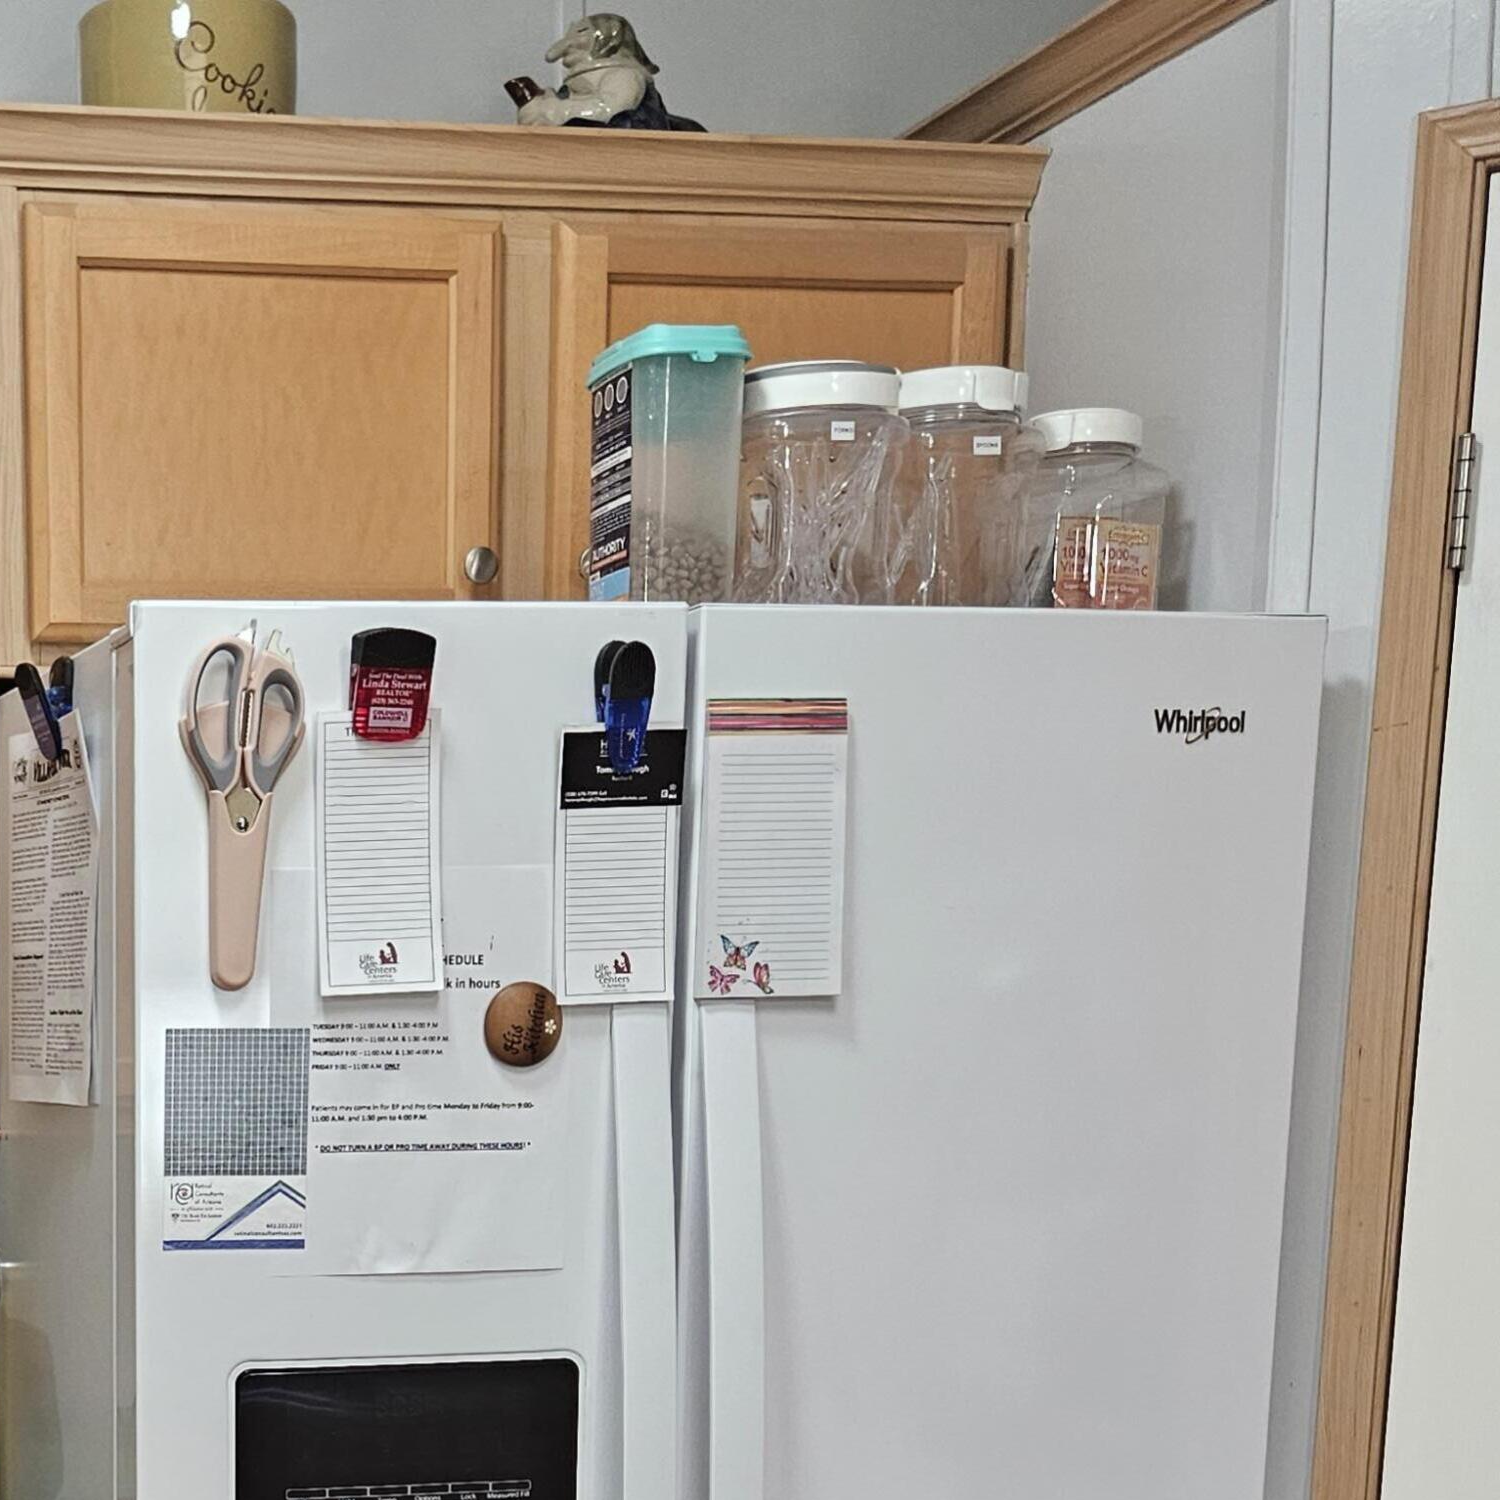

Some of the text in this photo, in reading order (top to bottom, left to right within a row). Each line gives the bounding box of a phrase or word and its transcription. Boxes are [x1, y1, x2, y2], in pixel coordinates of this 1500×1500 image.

[362, 678, 428, 690] Linda Stewart
[1154, 707, 1246, 743] Whirlpool
[443, 954, 484, 965] HEDULE
[364, 967, 398, 975] Centers
[455, 977, 466, 988] in
[469, 977, 501, 988] hours
[523, 991, 547, 1055] Kitchen
[503, 1023, 523, 1055] His
[443, 1103, 471, 1111] Monday
[480, 1102, 501, 1111] Friday
[348, 1144, 366, 1152] TURN
[411, 1143, 428, 1151] TIME
[430, 1143, 451, 1151] AWAY
[451, 1143, 478, 1151] DURING
[479, 1142, 500, 1150] THESE
[460, 1492, 476, 1500] Lock
[487, 1491, 519, 1499] Measured
